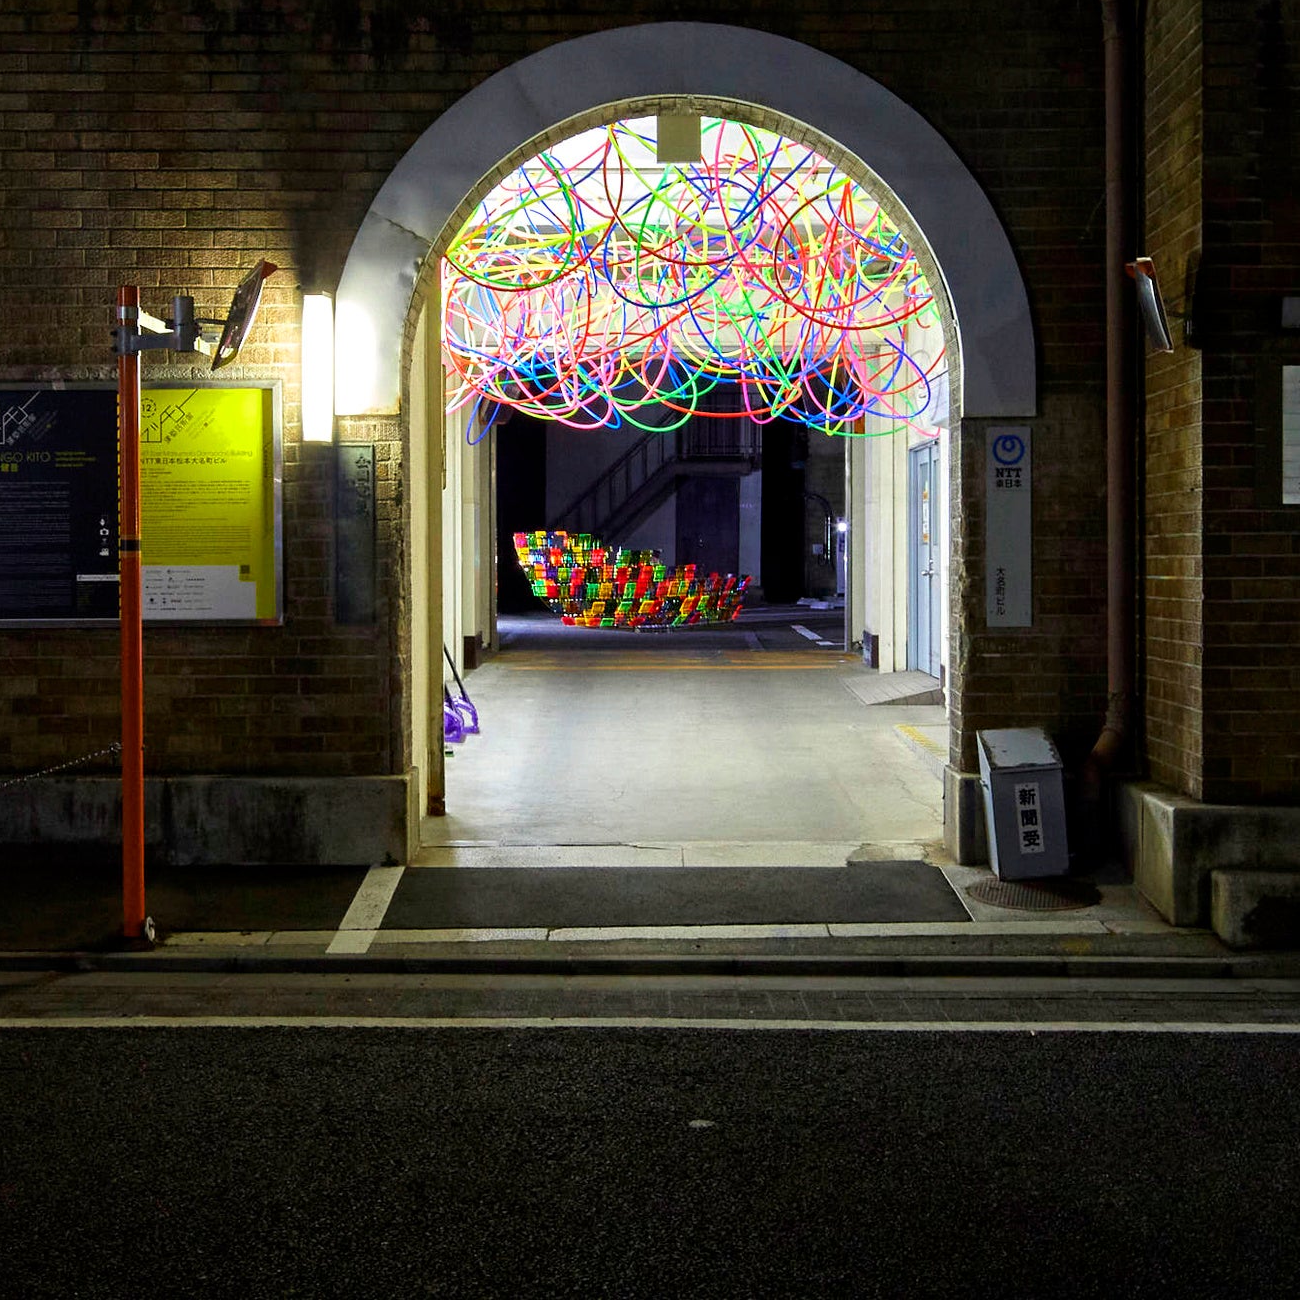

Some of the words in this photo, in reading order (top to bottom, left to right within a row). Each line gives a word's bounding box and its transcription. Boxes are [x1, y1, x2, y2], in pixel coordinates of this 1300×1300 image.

[142, 404, 152, 412] 12
[995, 467, 1022, 478] NTT
[995, 478, 1022, 488] 東日本
[996, 566, 1006, 616] 大名町ビル
[1018, 788, 1040, 847] 新聞受
